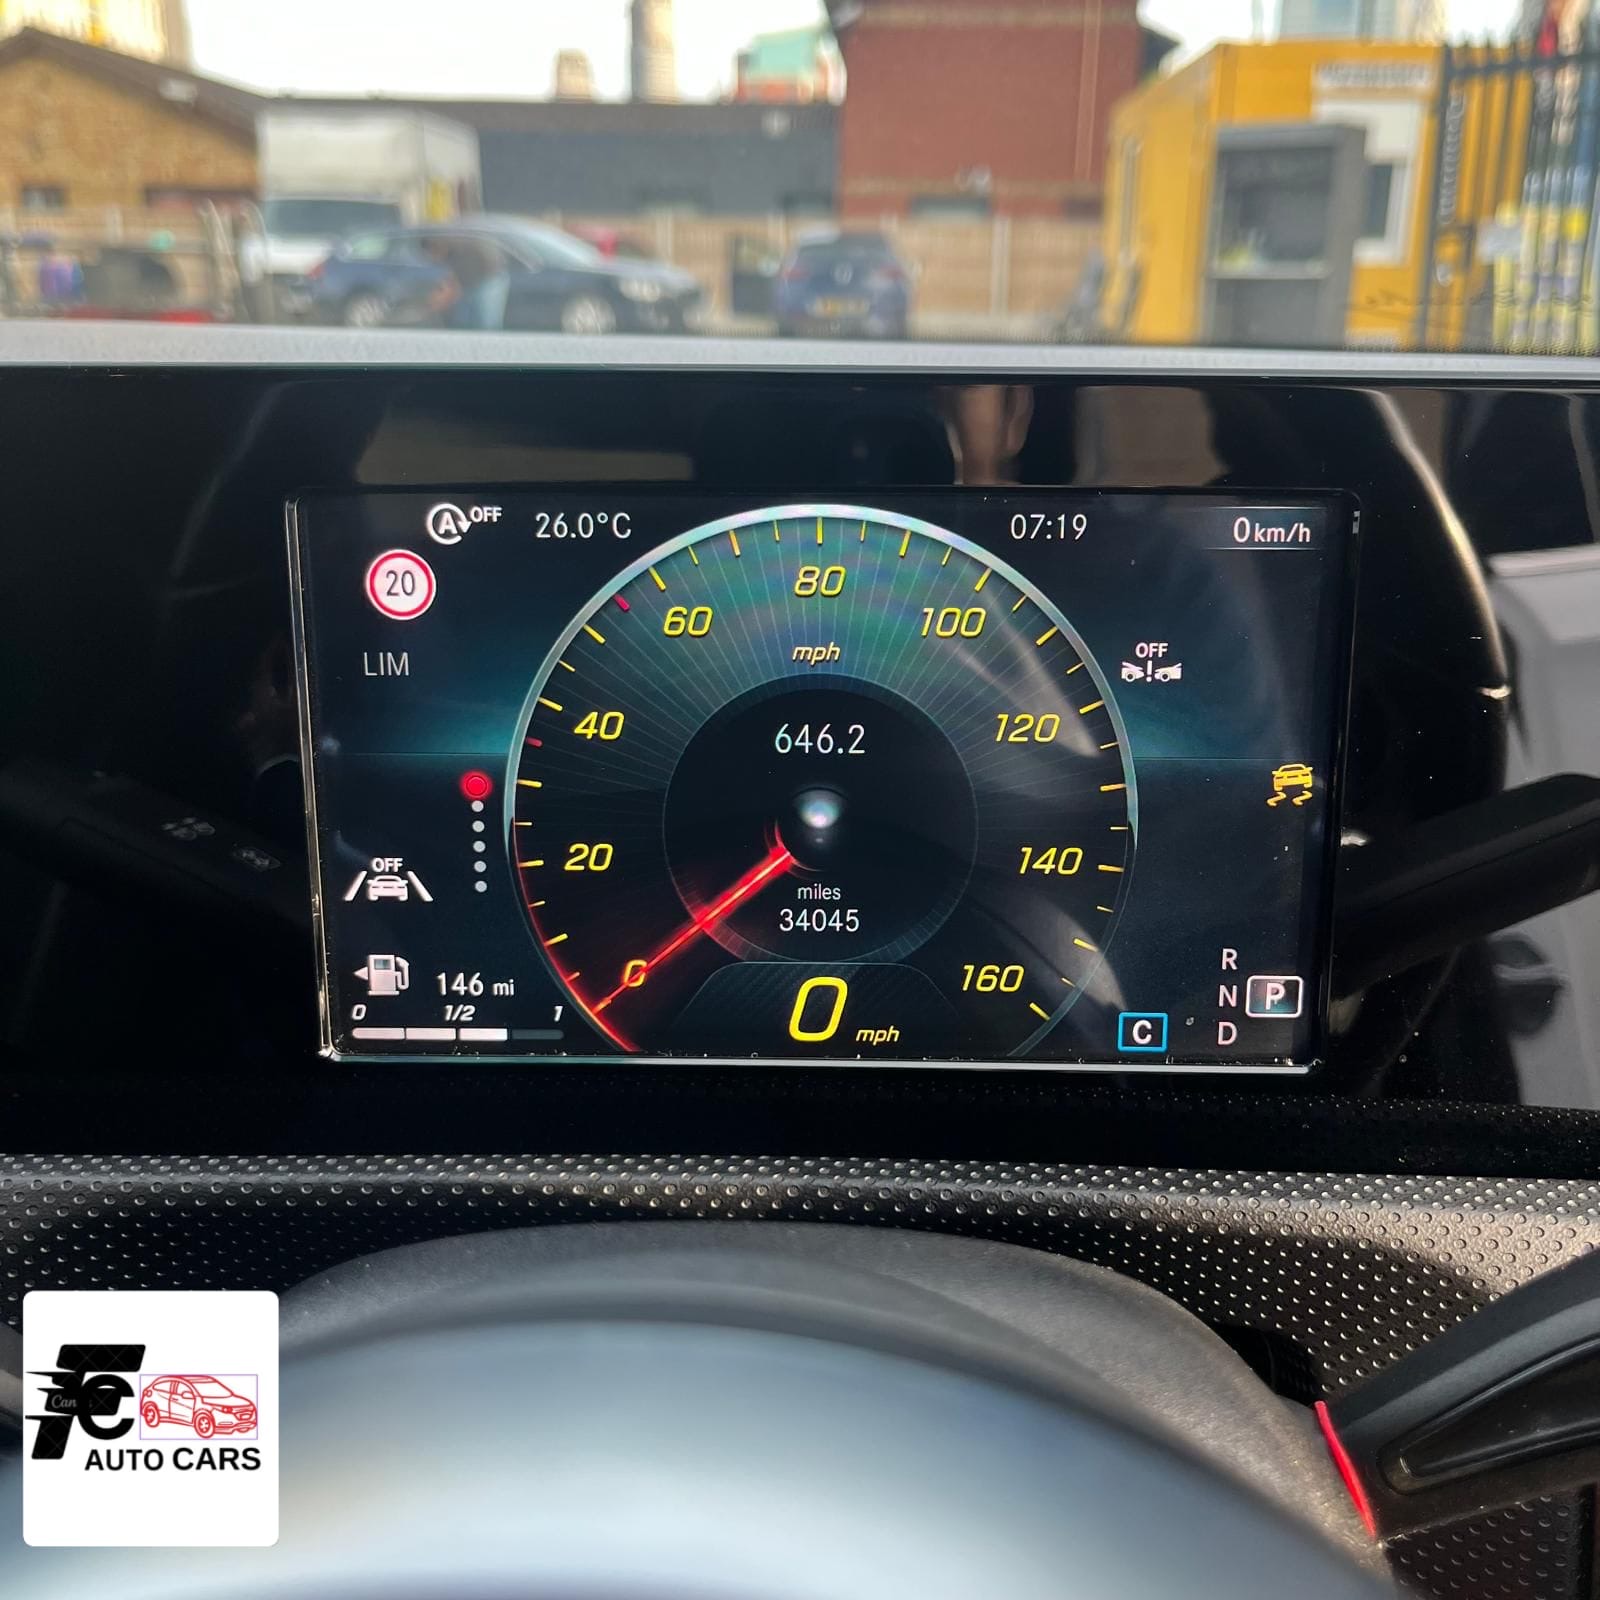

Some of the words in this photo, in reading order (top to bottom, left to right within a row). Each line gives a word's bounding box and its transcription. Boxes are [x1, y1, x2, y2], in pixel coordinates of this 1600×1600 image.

[438, 511, 457, 534] A
[470, 506, 502, 523] OFF
[535, 512, 632, 539] 26.0°C
[1010, 513, 1087, 540] 07:19
[385, 569, 416, 597] 20
[793, 565, 846, 596] 80
[663, 606, 713, 636] 60
[921, 607, 987, 637] 100
[363, 651, 410, 676] LIM
[792, 641, 841, 666] mph
[1135, 642, 1169, 659] OFF
[573, 711, 625, 740] 40
[775, 723, 866, 755] 646.2
[996, 713, 1061, 743] 120
[371, 857, 403, 873] OFF
[564, 843, 614, 872] 20
[1019, 847, 1084, 875] 140
[797, 883, 841, 901] miles
[779, 908, 860, 932] 34045
[1221, 948, 1238, 970] R
[437, 972, 484, 997] 146
[492, 978, 515, 996] mi
[622, 958, 648, 988] 0
[962, 964, 1025, 993] 160
[1218, 984, 1238, 1007] N
[1265, 979, 1286, 1011] P
[351, 1004, 367, 1021] 0
[445, 1004, 476, 1022] 1/2
[554, 1005, 563, 1022] 1
[789, 976, 848, 1042] 0
[855, 1025, 900, 1046] mph
[1132, 1019, 1152, 1045] C
[1217, 1021, 1238, 1045] D
